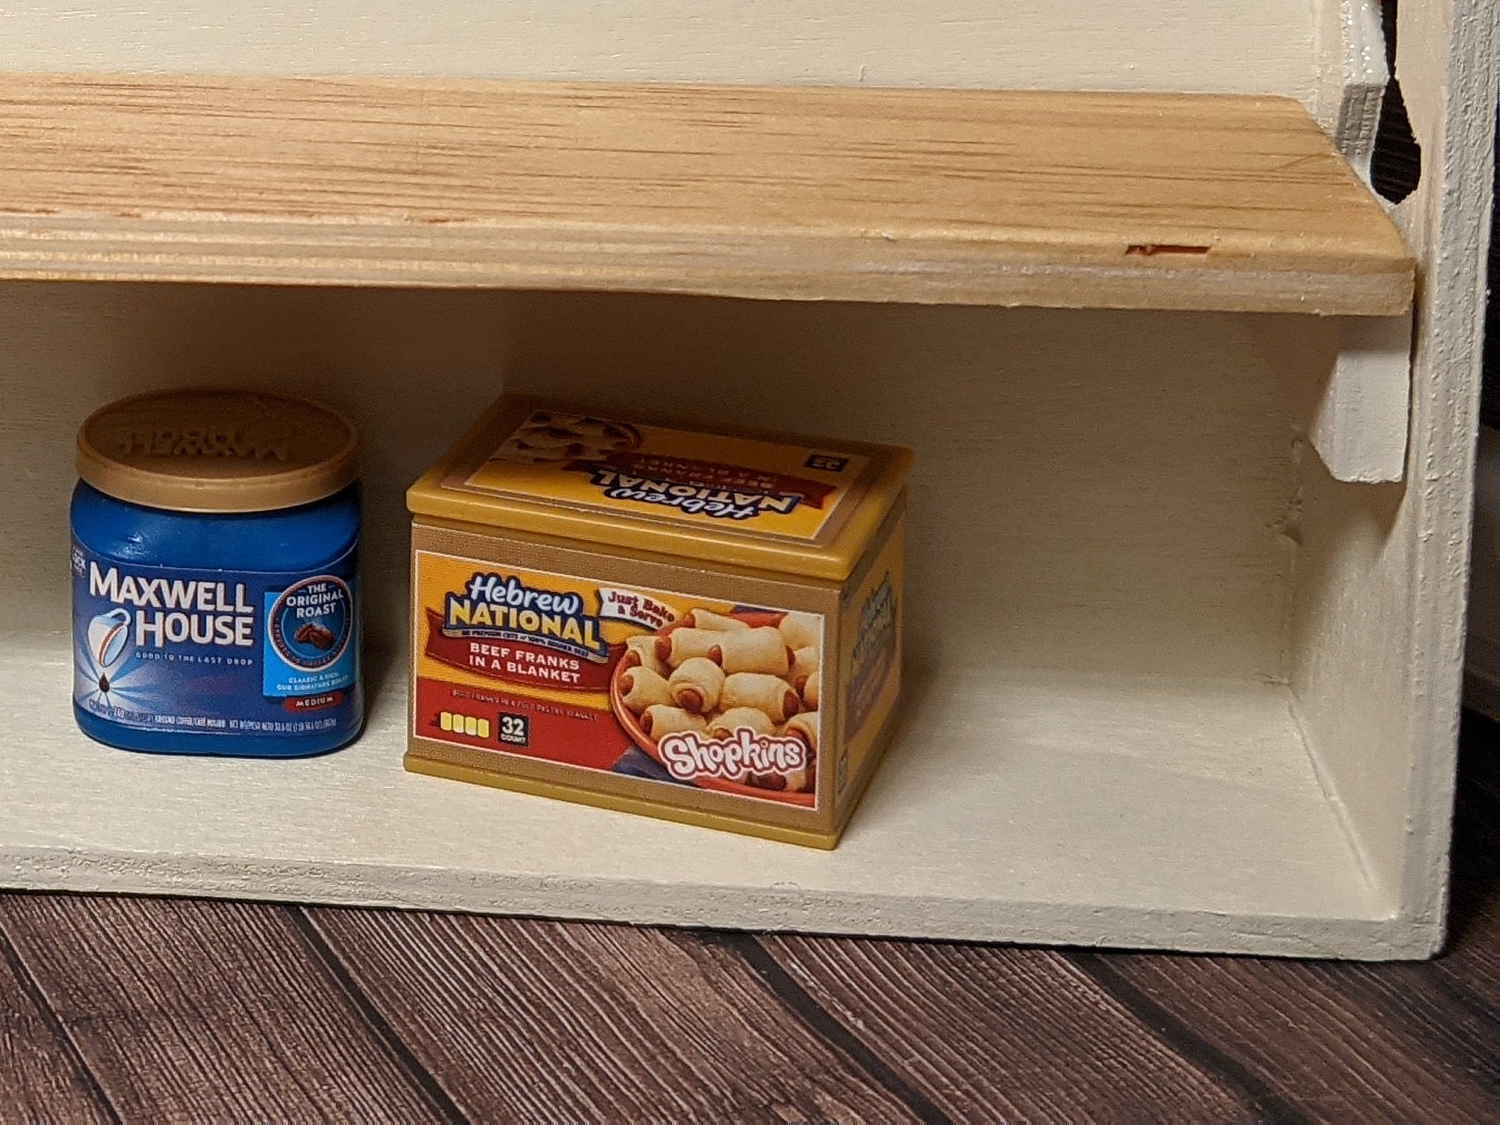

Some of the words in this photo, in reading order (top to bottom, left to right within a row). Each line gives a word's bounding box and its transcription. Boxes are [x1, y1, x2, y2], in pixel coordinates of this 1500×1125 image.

[591, 469, 791, 512] NATIONAL
[610, 488, 754, 519] Hebrew
[89, 561, 254, 614] MAXWELL
[286, 589, 345, 607] ORIGINAL
[307, 583, 327, 594] THE
[470, 574, 578, 613] Hebrew
[296, 602, 337, 619] ROAST
[608, 591, 639, 606] Just
[642, 598, 675, 623] Bake
[629, 605, 663, 627] Serve
[135, 610, 254, 647] HOUSE
[450, 598, 601, 650] NATIONAL
[135, 651, 160, 660] GOOD
[163, 652, 175, 661] TO
[178, 654, 195, 663] THE
[197, 656, 222, 664] LAST
[226, 658, 253, 666] DROP
[469, 655, 486, 668] IN
[490, 659, 502, 670] A
[506, 661, 581, 684] BLANKET
[470, 642, 511, 658] BEEF
[515, 650, 581, 670] FRANKS
[295, 697, 334, 708] MEDIUM
[500, 733, 526, 744] COUNT
[501, 716, 525, 736] 32
[661, 731, 804, 776] Shopkins
